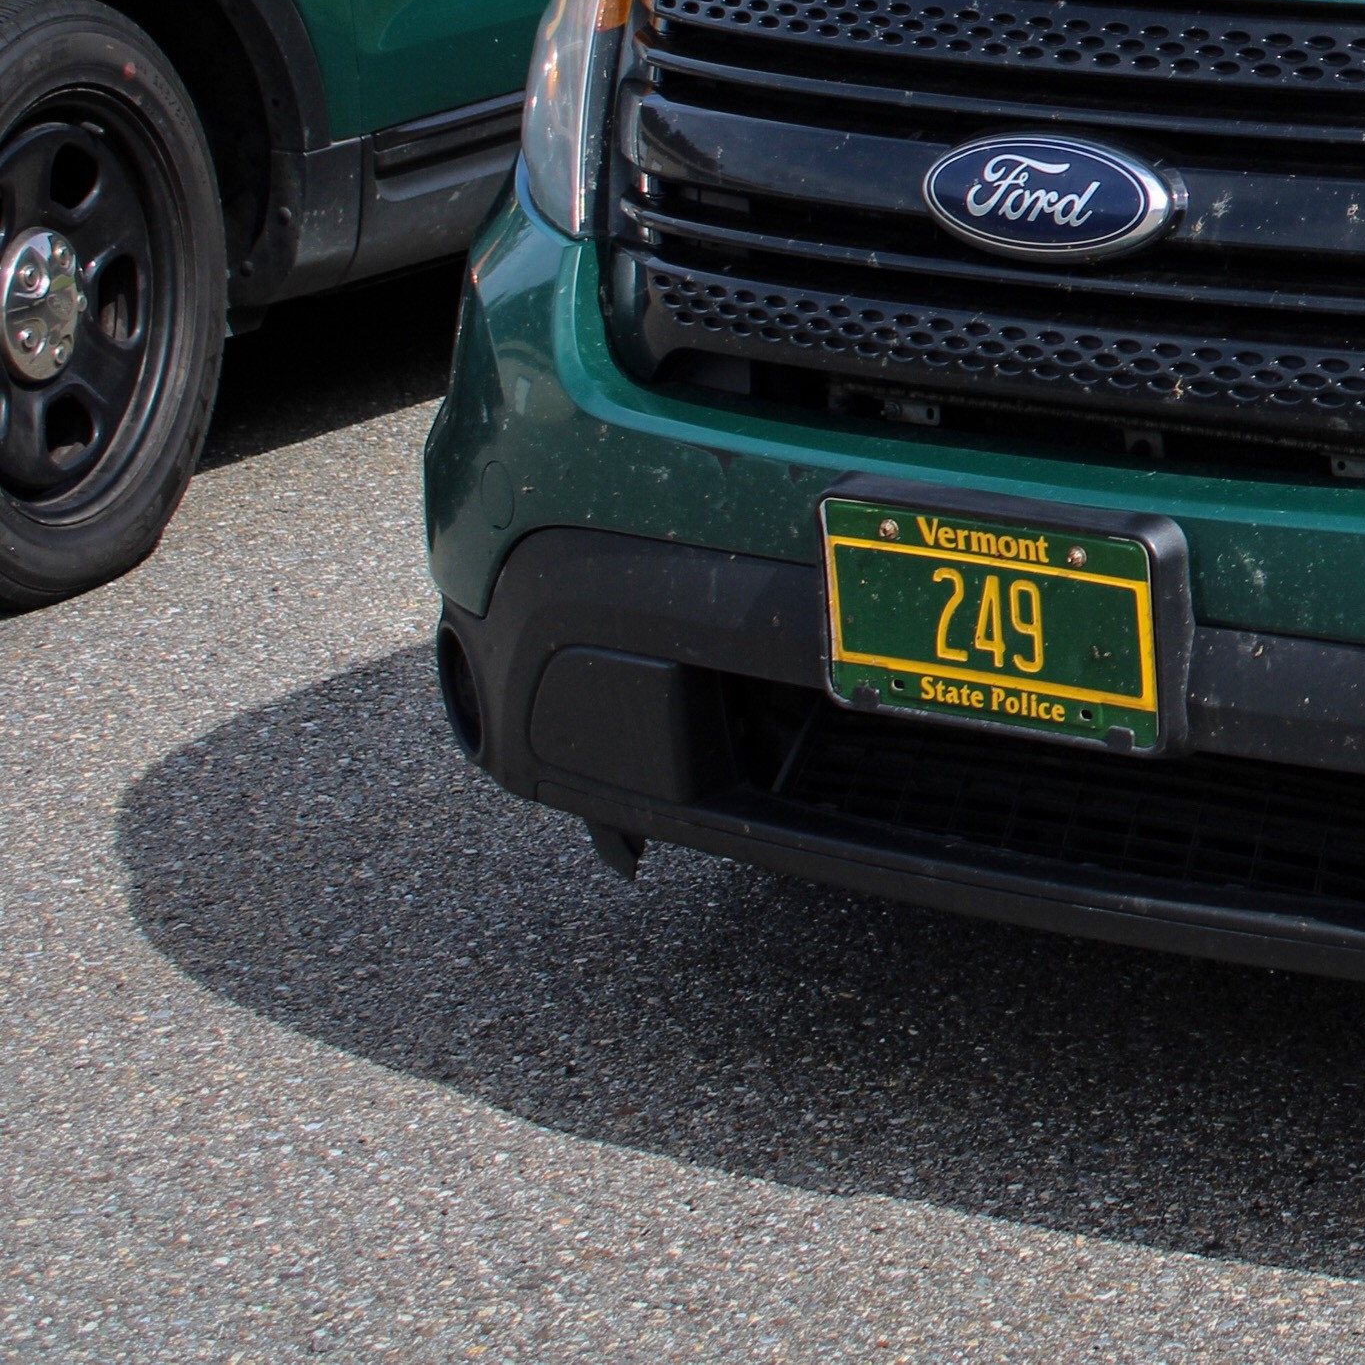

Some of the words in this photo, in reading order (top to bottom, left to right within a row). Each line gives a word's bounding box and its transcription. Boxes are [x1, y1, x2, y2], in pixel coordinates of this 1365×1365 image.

[966, 154, 1101, 227] Ford
[916, 516, 1050, 564] Vermont
[932, 567, 1045, 674] 249
[920, 676, 984, 710] State
[992, 687, 1066, 723] Police
